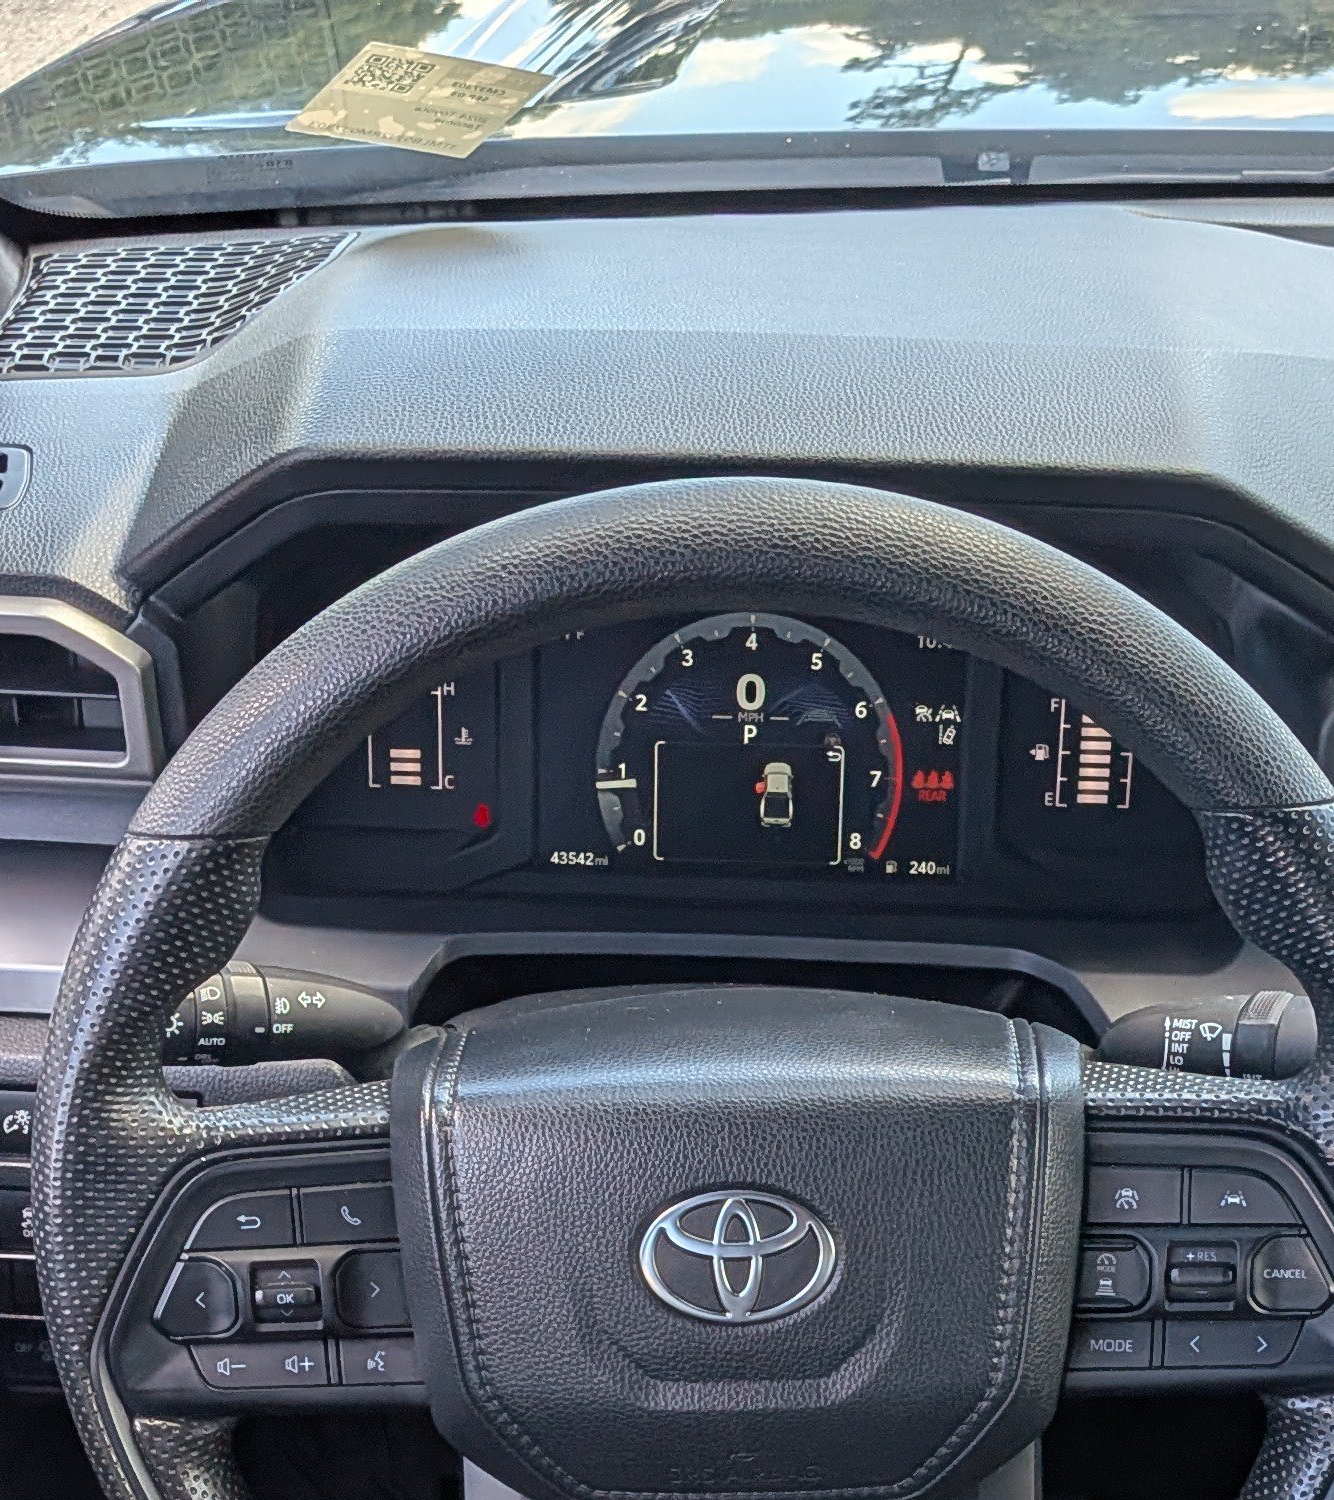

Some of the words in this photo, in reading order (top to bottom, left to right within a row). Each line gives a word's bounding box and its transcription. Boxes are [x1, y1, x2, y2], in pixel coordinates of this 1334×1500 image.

[745, 633, 758, 651] 4
[682, 649, 694, 667] 3
[811, 653, 823, 670] 5
[736, 673, 766, 711] 0
[635, 694, 648, 712] 2
[854, 701, 867, 718] 6
[737, 712, 764, 723] MPH
[743, 725, 758, 744] P
[618, 762, 627, 780] 1
[870, 770, 882, 788] 7
[633, 829, 646, 846] 0
[849, 832, 862, 850] 8
[273, 1023, 295, 1034] OFF
[1172, 1018, 1198, 1030] MIST
[197, 1037, 226, 1047] AUTO
[1171, 1031, 1192, 1042] OFF
[1171, 1043, 1189, 1054] INT
[1170, 1055, 1184, 1066] LO
[1263, 1268, 1307, 1280] CANCEL
[276, 1293, 295, 1305] OK
[1090, 1339, 1133, 1353] MODE
